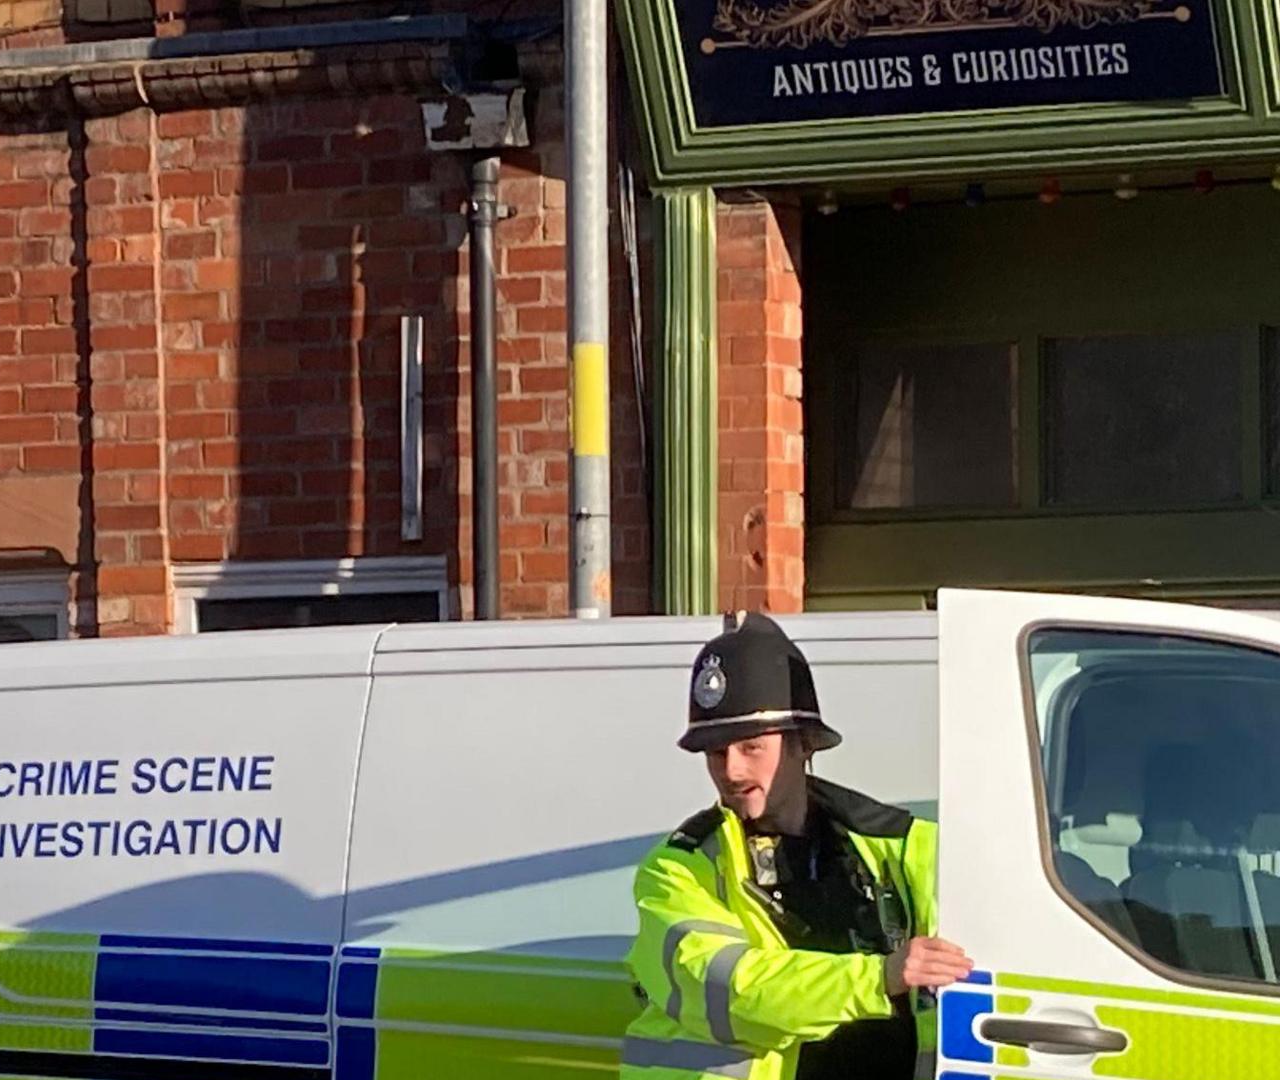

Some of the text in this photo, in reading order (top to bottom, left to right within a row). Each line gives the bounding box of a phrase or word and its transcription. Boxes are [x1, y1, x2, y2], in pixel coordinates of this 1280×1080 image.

[773, 43, 1130, 97] ANTIQUES & CURIOSITIES
[131, 755, 276, 794] SCENE
